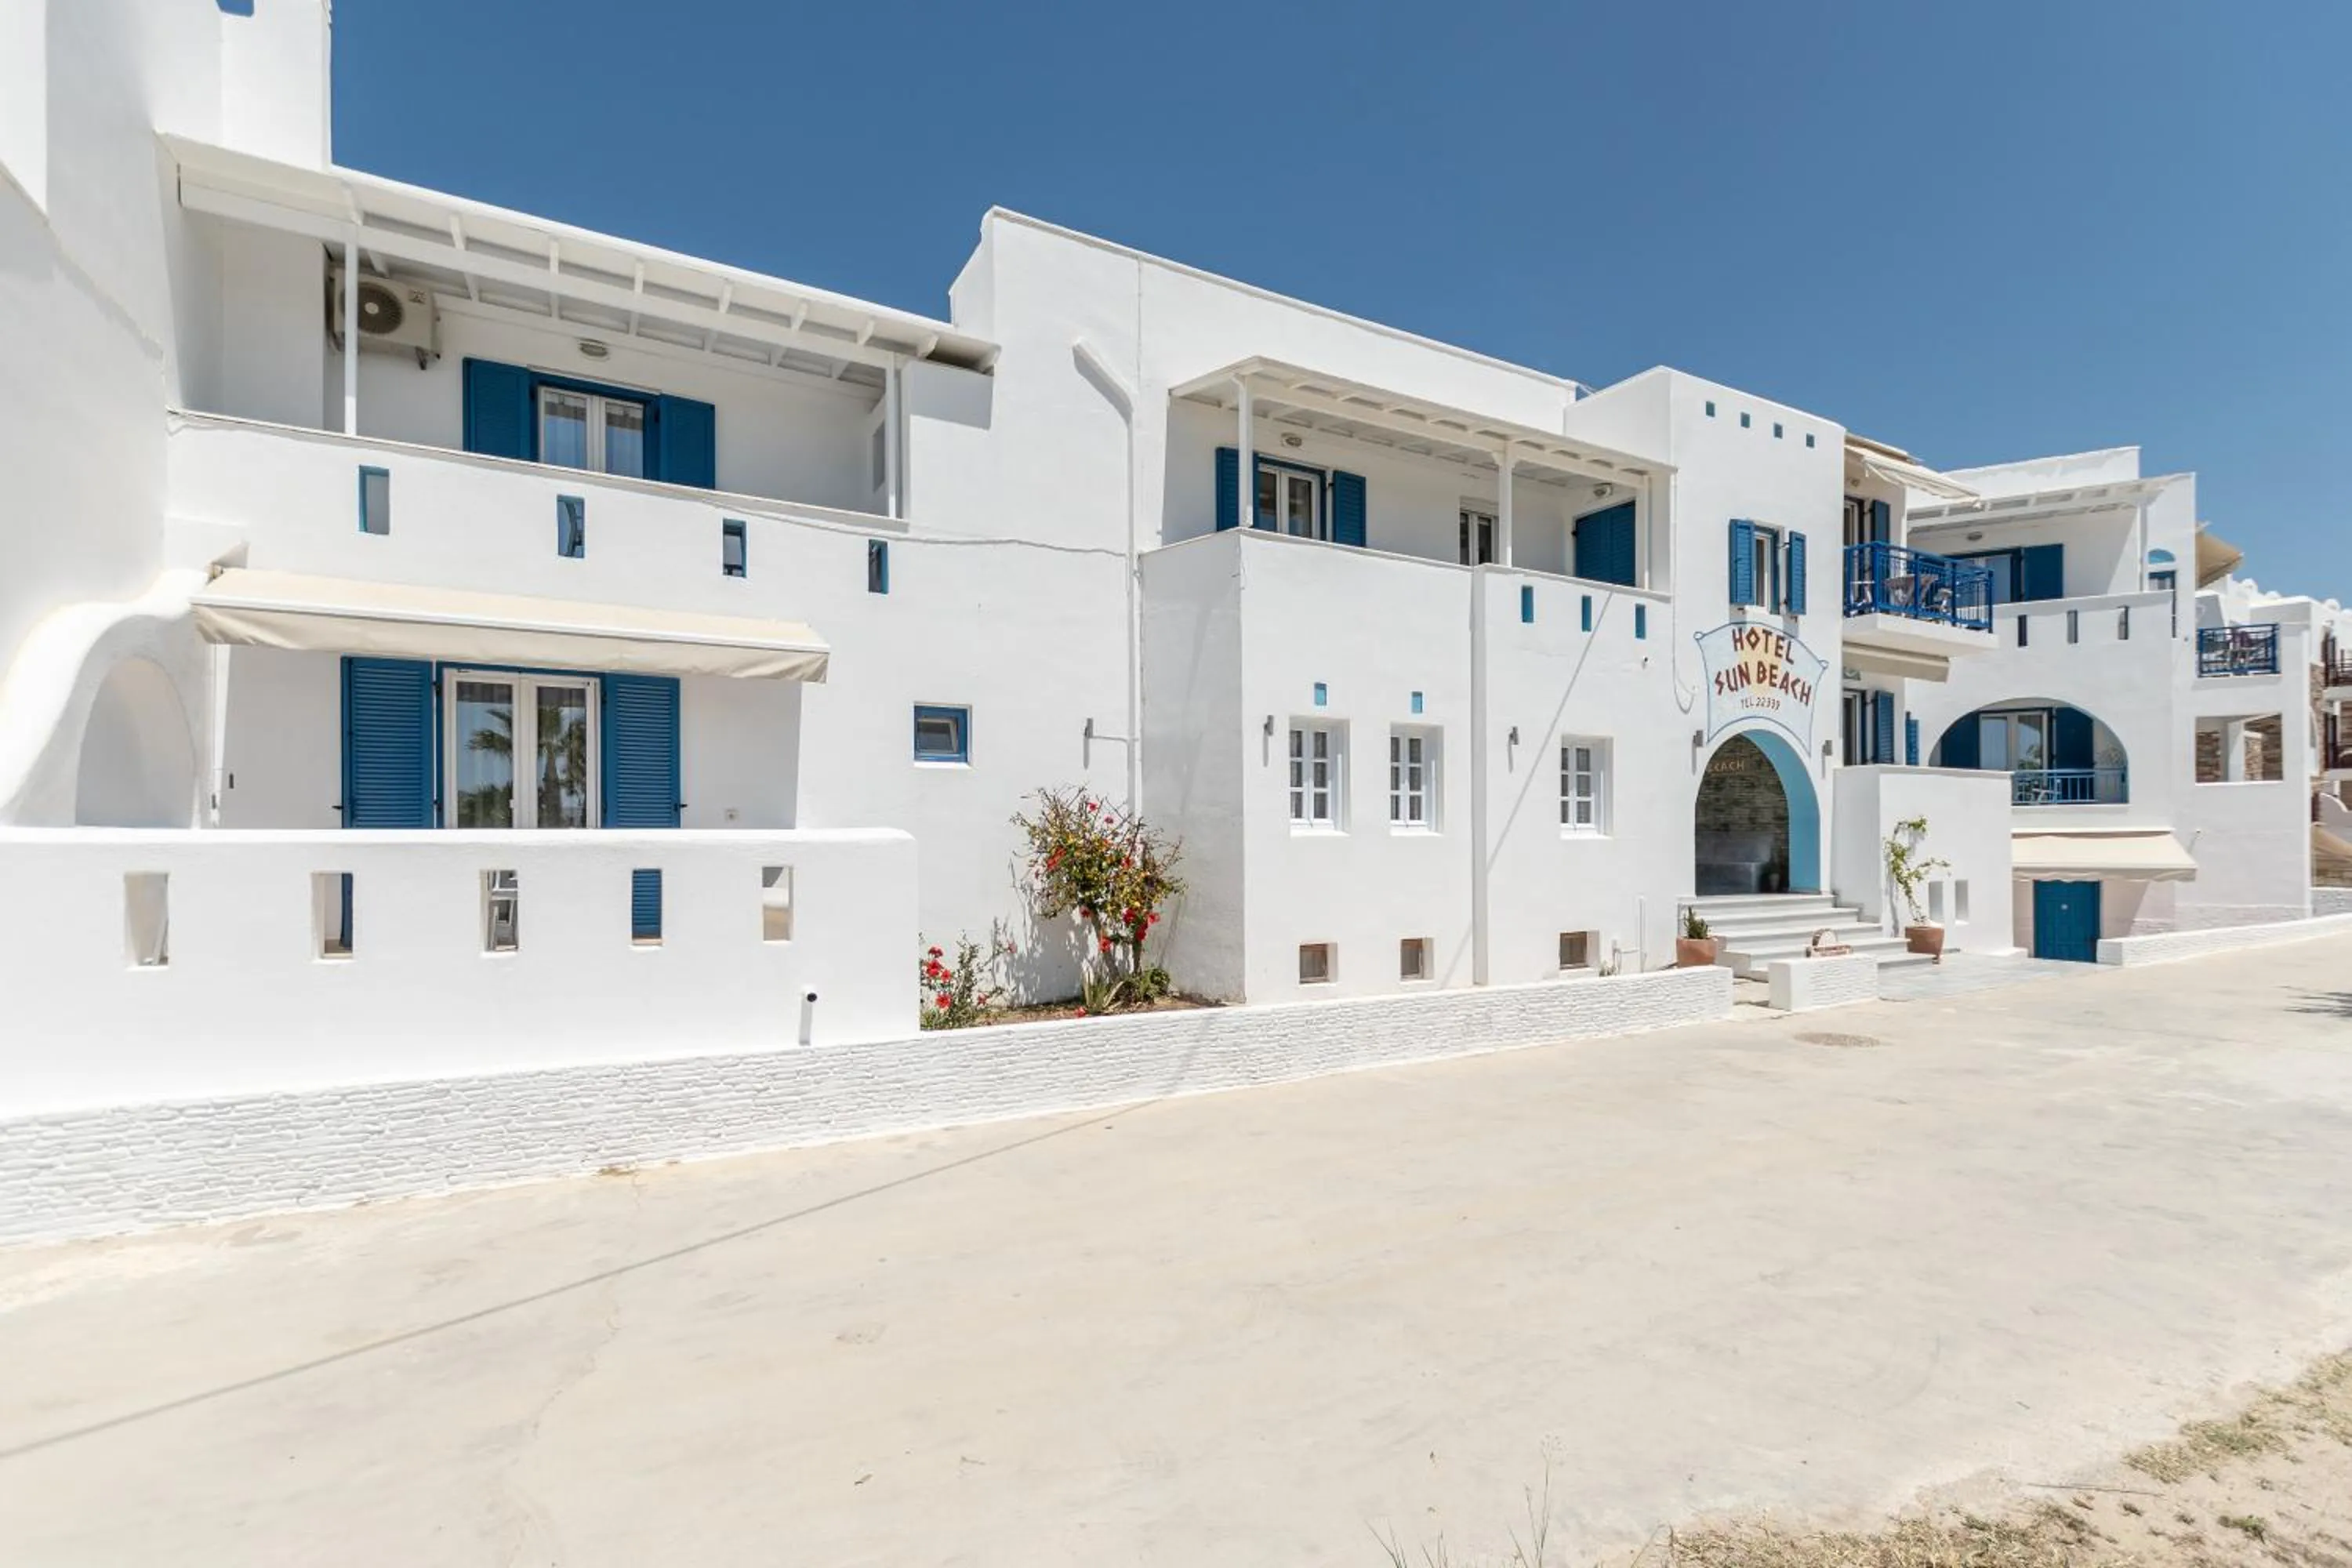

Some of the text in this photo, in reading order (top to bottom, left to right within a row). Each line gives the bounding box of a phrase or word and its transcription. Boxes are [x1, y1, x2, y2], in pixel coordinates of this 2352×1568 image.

[1732, 626, 1795, 665] HOTEL
[1715, 661, 1812, 706] SUN BEACH
